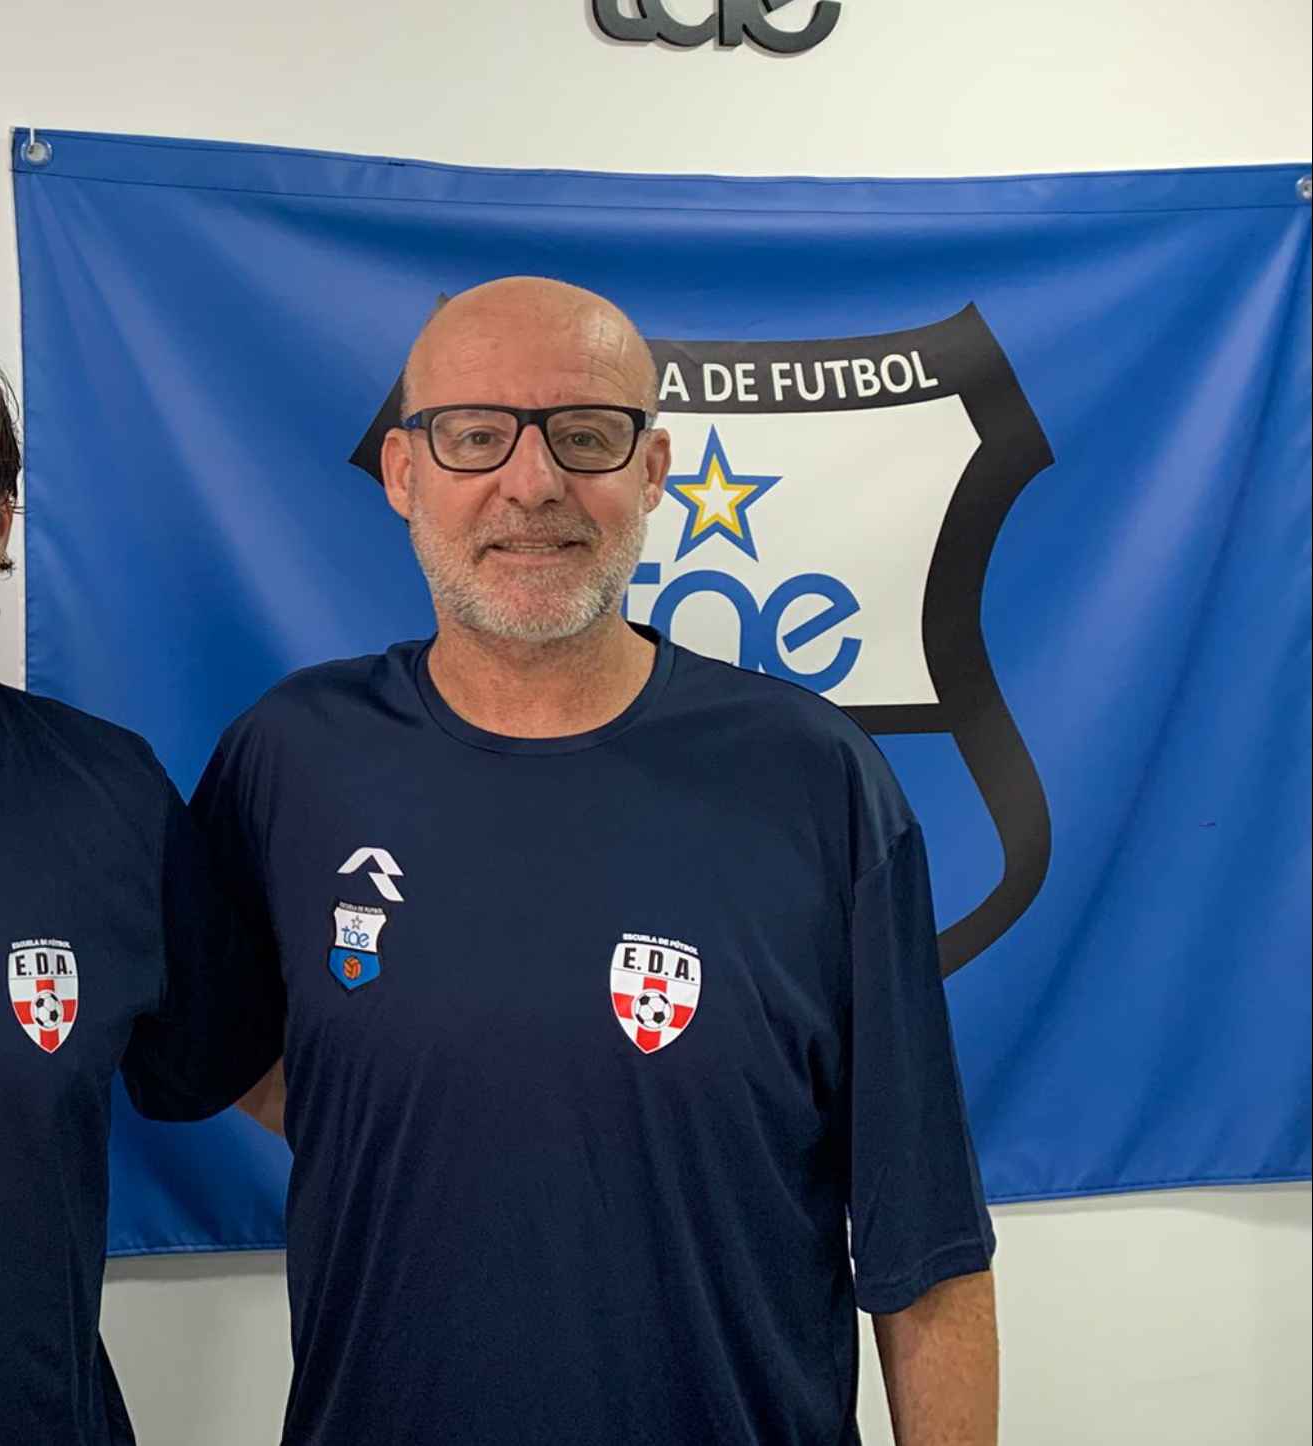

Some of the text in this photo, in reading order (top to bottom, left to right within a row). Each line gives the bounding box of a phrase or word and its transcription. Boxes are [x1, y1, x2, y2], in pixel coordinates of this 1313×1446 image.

[702, 362, 759, 402] DE
[770, 350, 939, 402] FUTBOL
[621, 562, 863, 694] ae
[341, 926, 370, 948] tae
